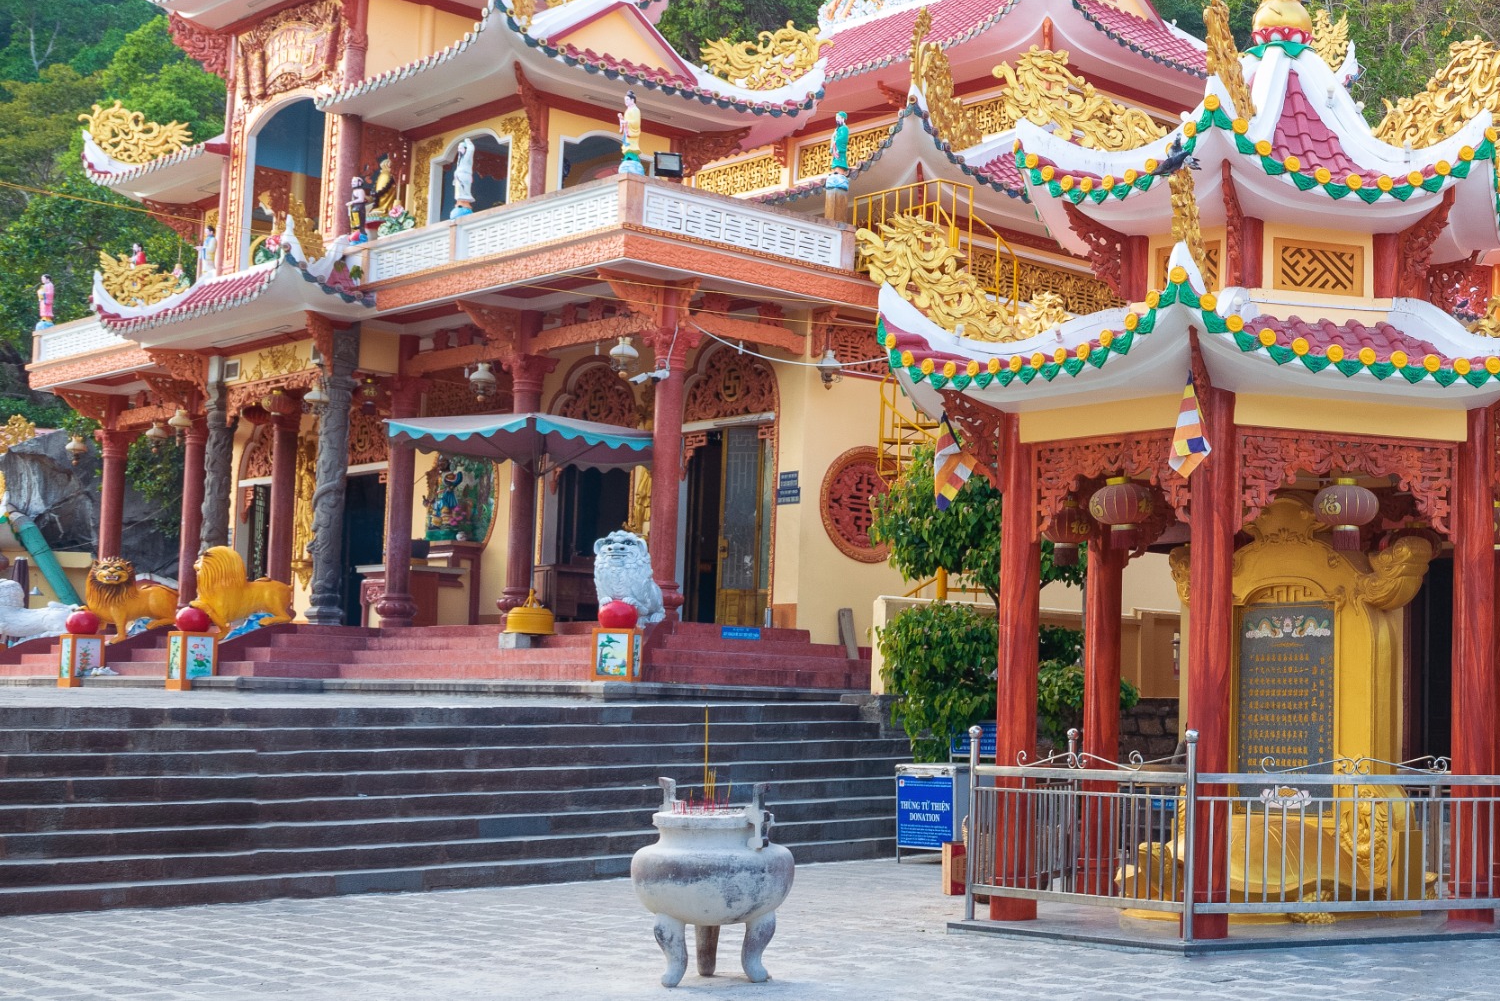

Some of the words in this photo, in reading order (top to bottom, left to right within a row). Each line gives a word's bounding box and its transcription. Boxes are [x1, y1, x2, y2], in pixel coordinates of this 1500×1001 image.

[1319, 493, 1342, 515] 福
[900, 799, 920, 810] THÙNG
[931, 800, 951, 813] THIỆN
[909, 812, 941, 822] DONATION
